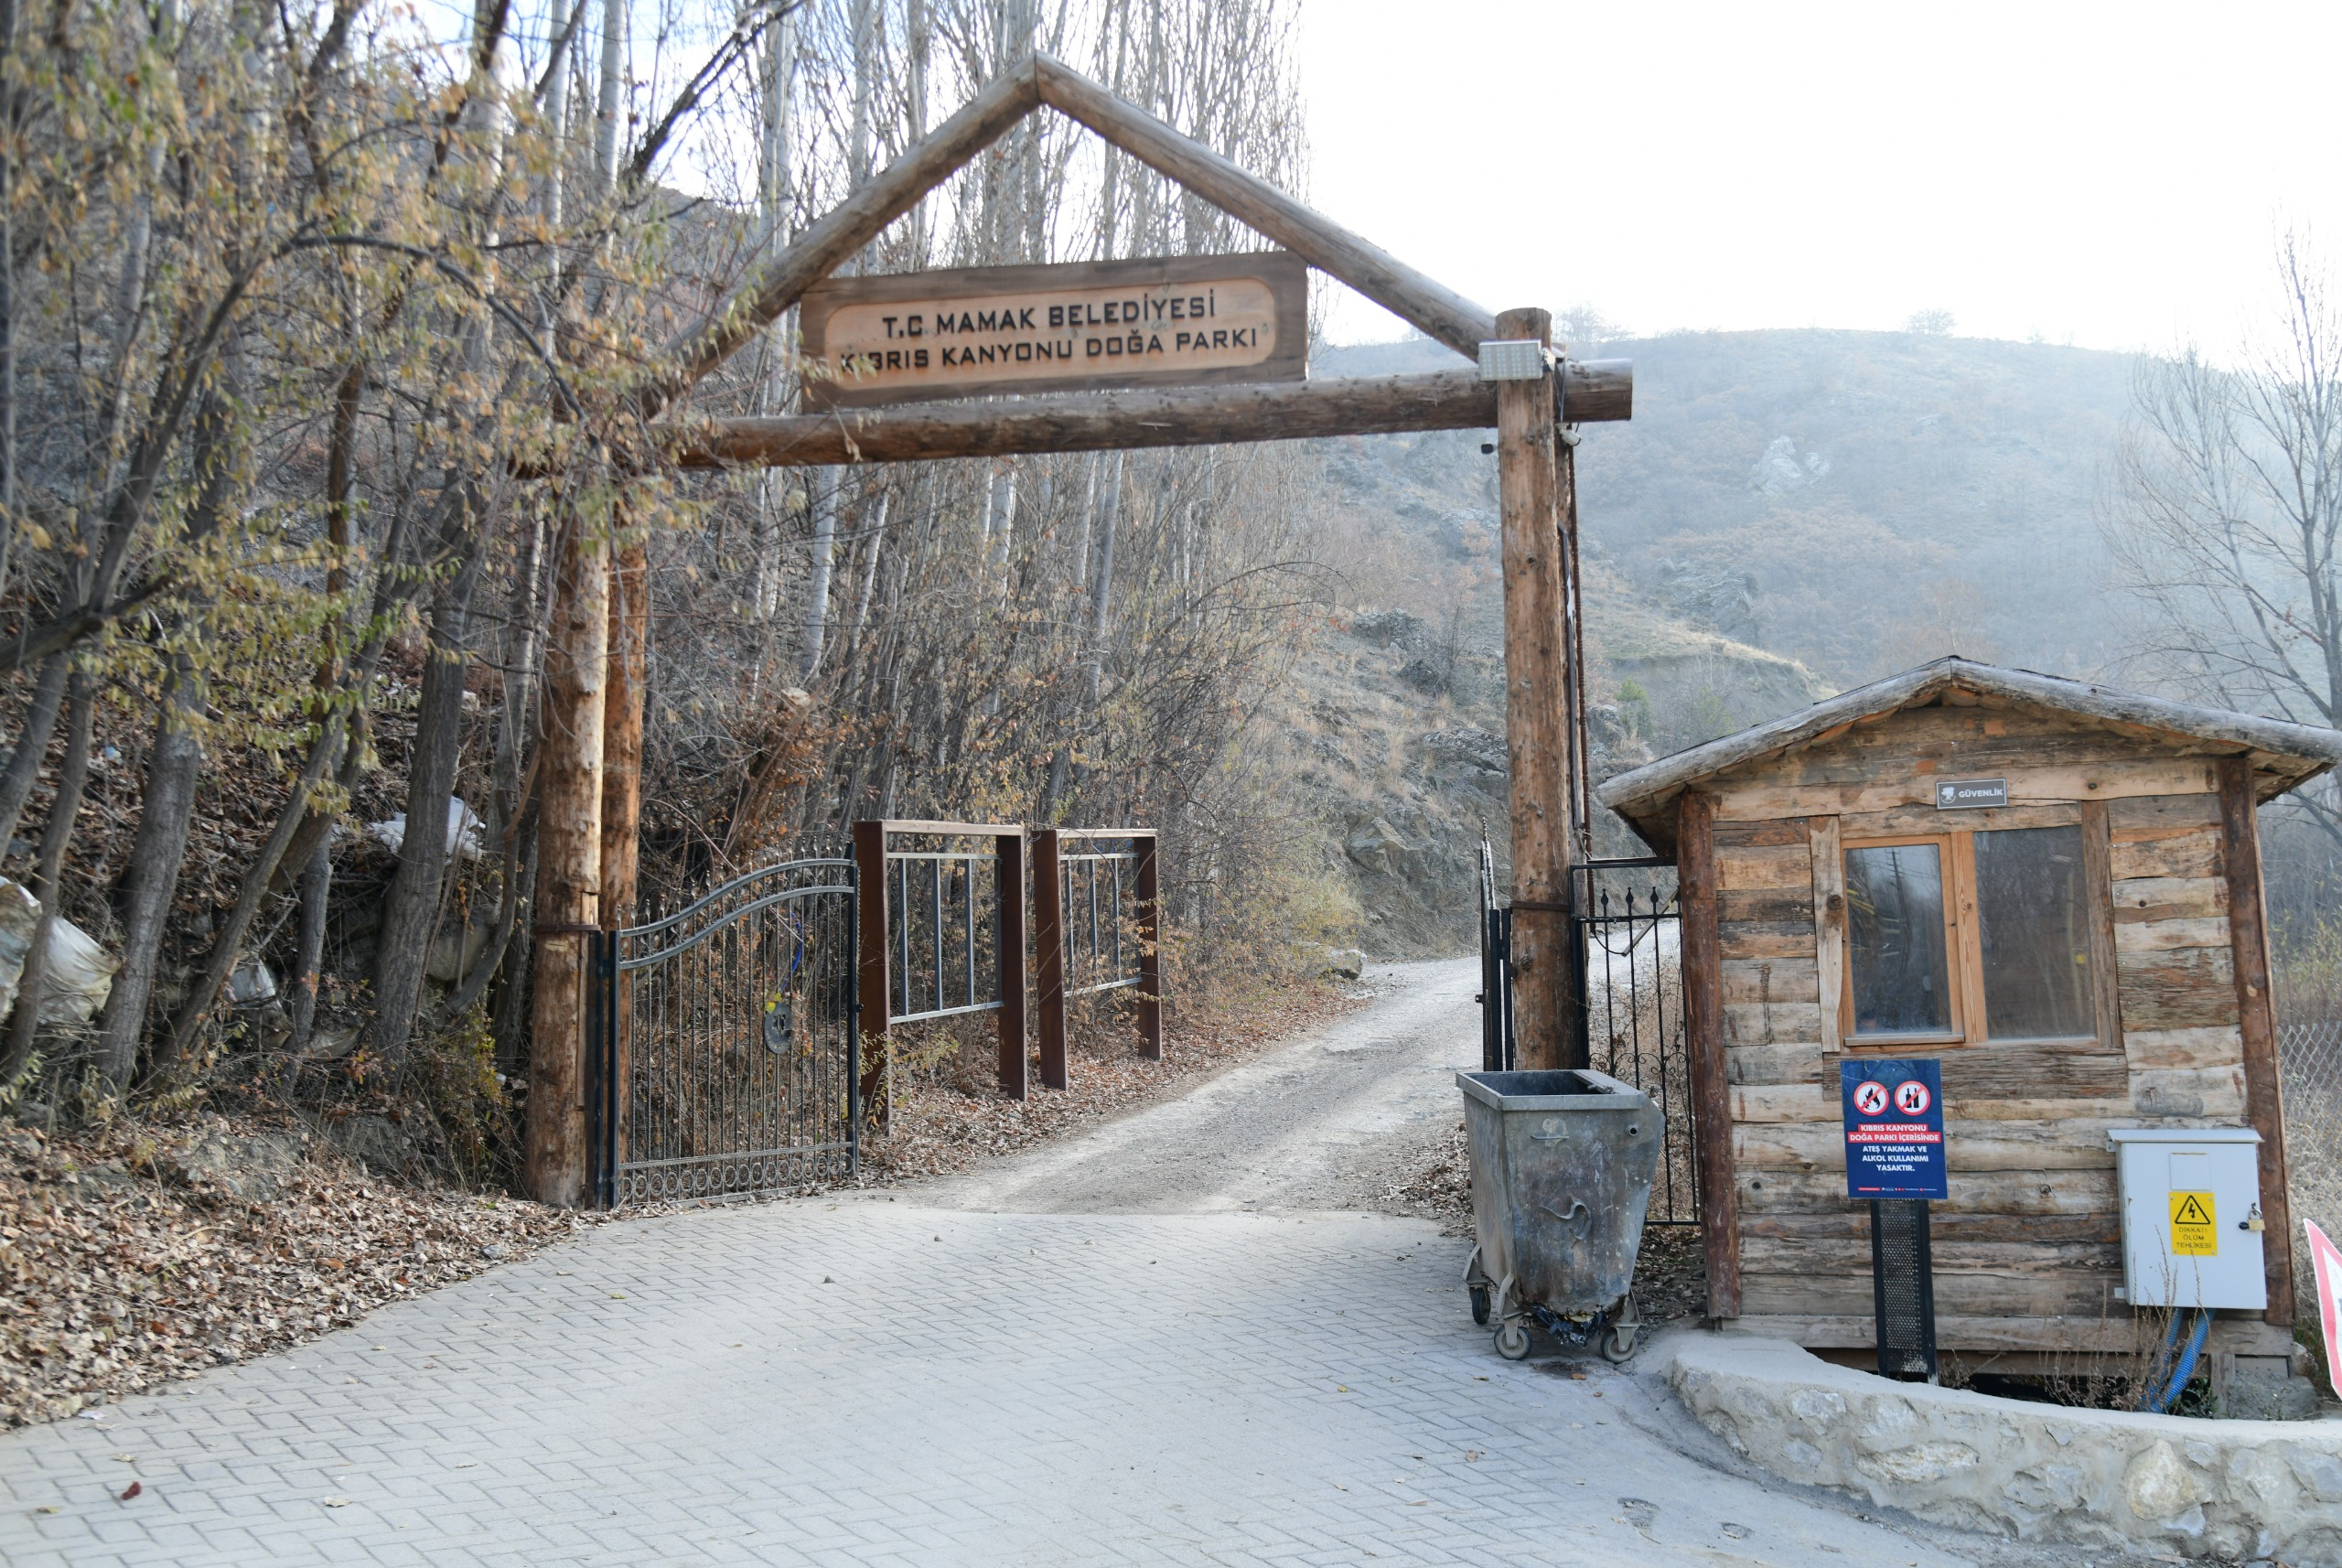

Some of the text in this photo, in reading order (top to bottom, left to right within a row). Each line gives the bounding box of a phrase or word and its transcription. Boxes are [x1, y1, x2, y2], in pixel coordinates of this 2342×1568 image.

[882, 289, 1215, 338] T.C MAMAK BELEDİYESİ
[942, 340, 1073, 367] KANYONU
[1086, 329, 1164, 358] DOĞA
[1176, 328, 1257, 352] PARKI
[1959, 789, 2004, 798] GÜVENLİK
[1898, 1133, 1939, 1142] İÇERİSİNDE
[1863, 1145, 1880, 1154] ATEŞ
